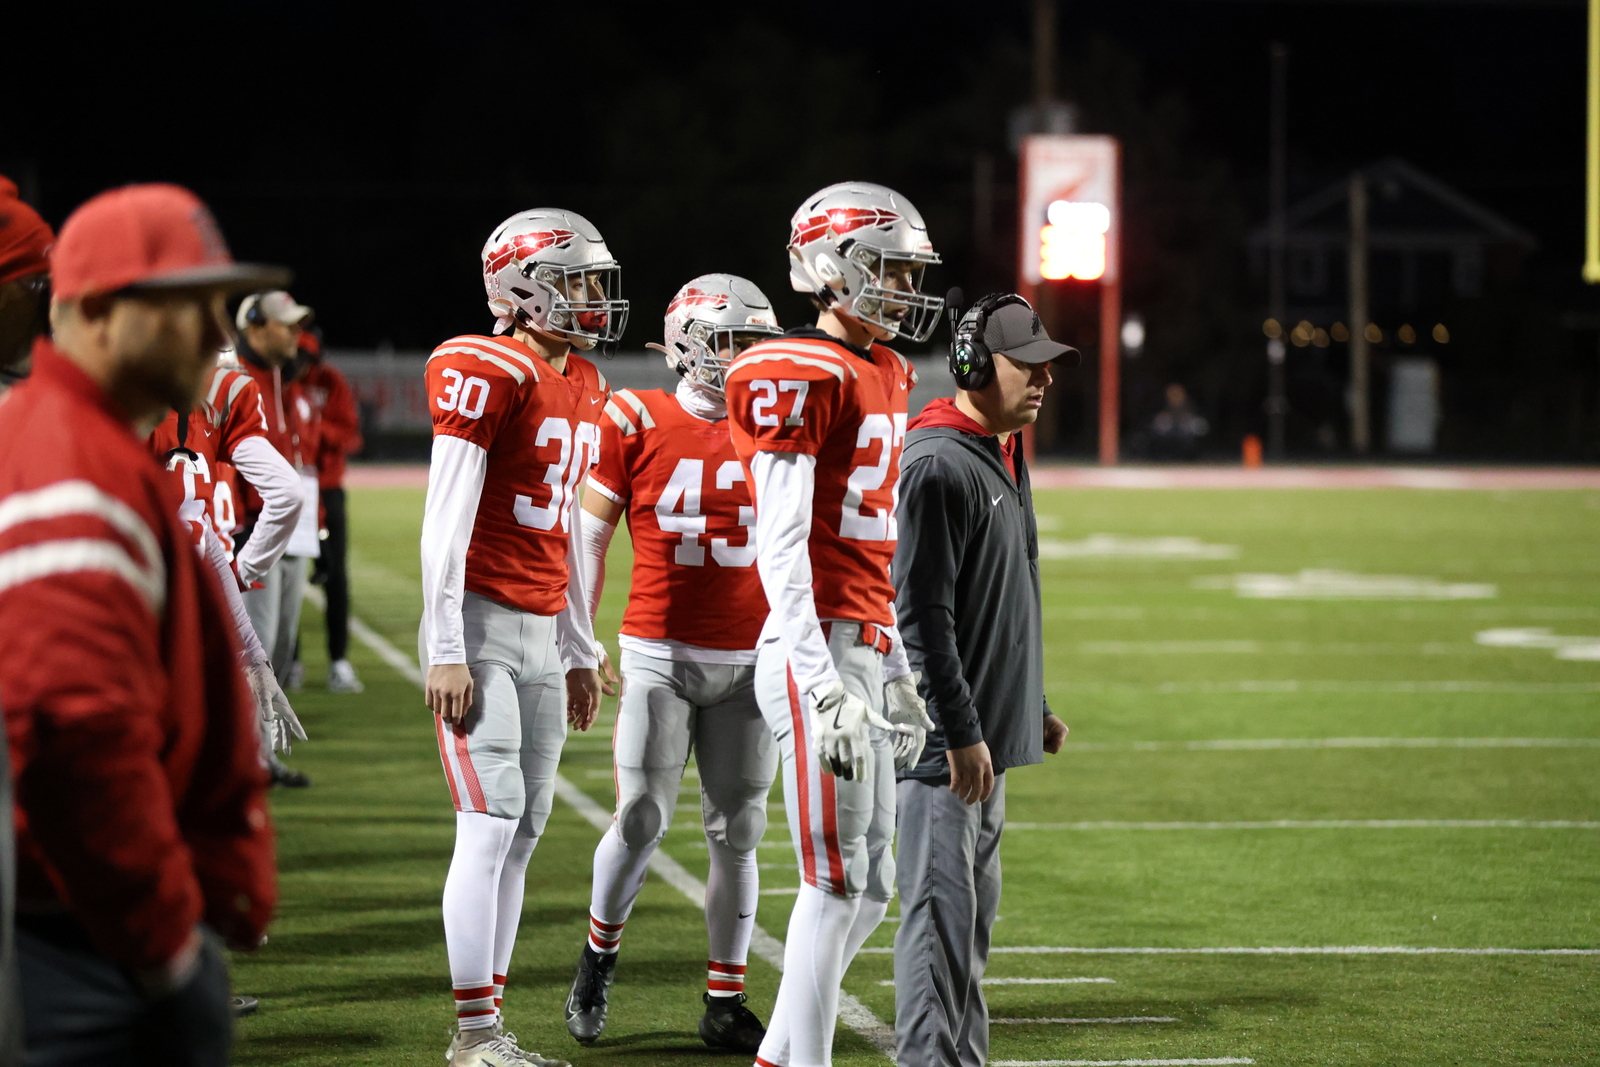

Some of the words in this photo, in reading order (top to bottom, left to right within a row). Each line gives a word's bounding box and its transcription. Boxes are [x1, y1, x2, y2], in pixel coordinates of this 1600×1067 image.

[437, 367, 491, 420] 30
[749, 379, 809, 427] 27
[654, 458, 757, 567] 43
